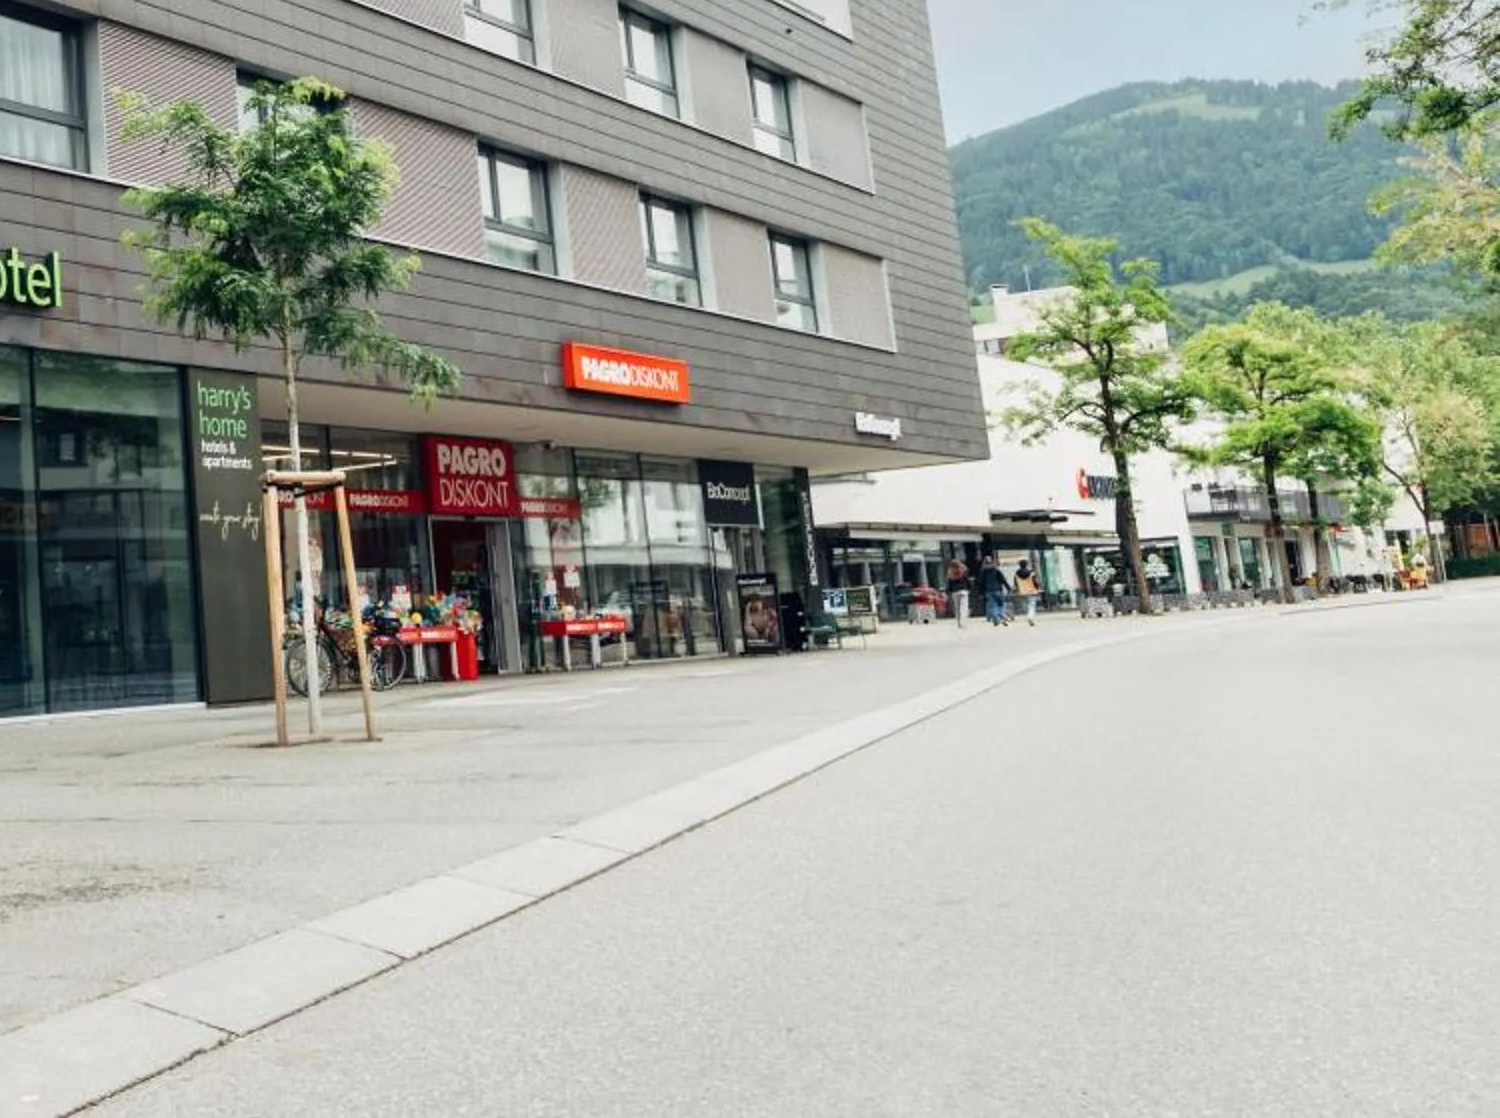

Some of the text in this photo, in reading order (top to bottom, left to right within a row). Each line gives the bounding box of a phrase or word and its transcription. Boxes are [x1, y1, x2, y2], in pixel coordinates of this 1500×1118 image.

[197, 380, 251, 415] harry's
[199, 410, 248, 439] home
[201, 439, 237, 455] hotels &
[438, 443, 507, 478] PAGRO
[202, 455, 253, 472] apartments
[440, 481, 510, 509] DISKONT
